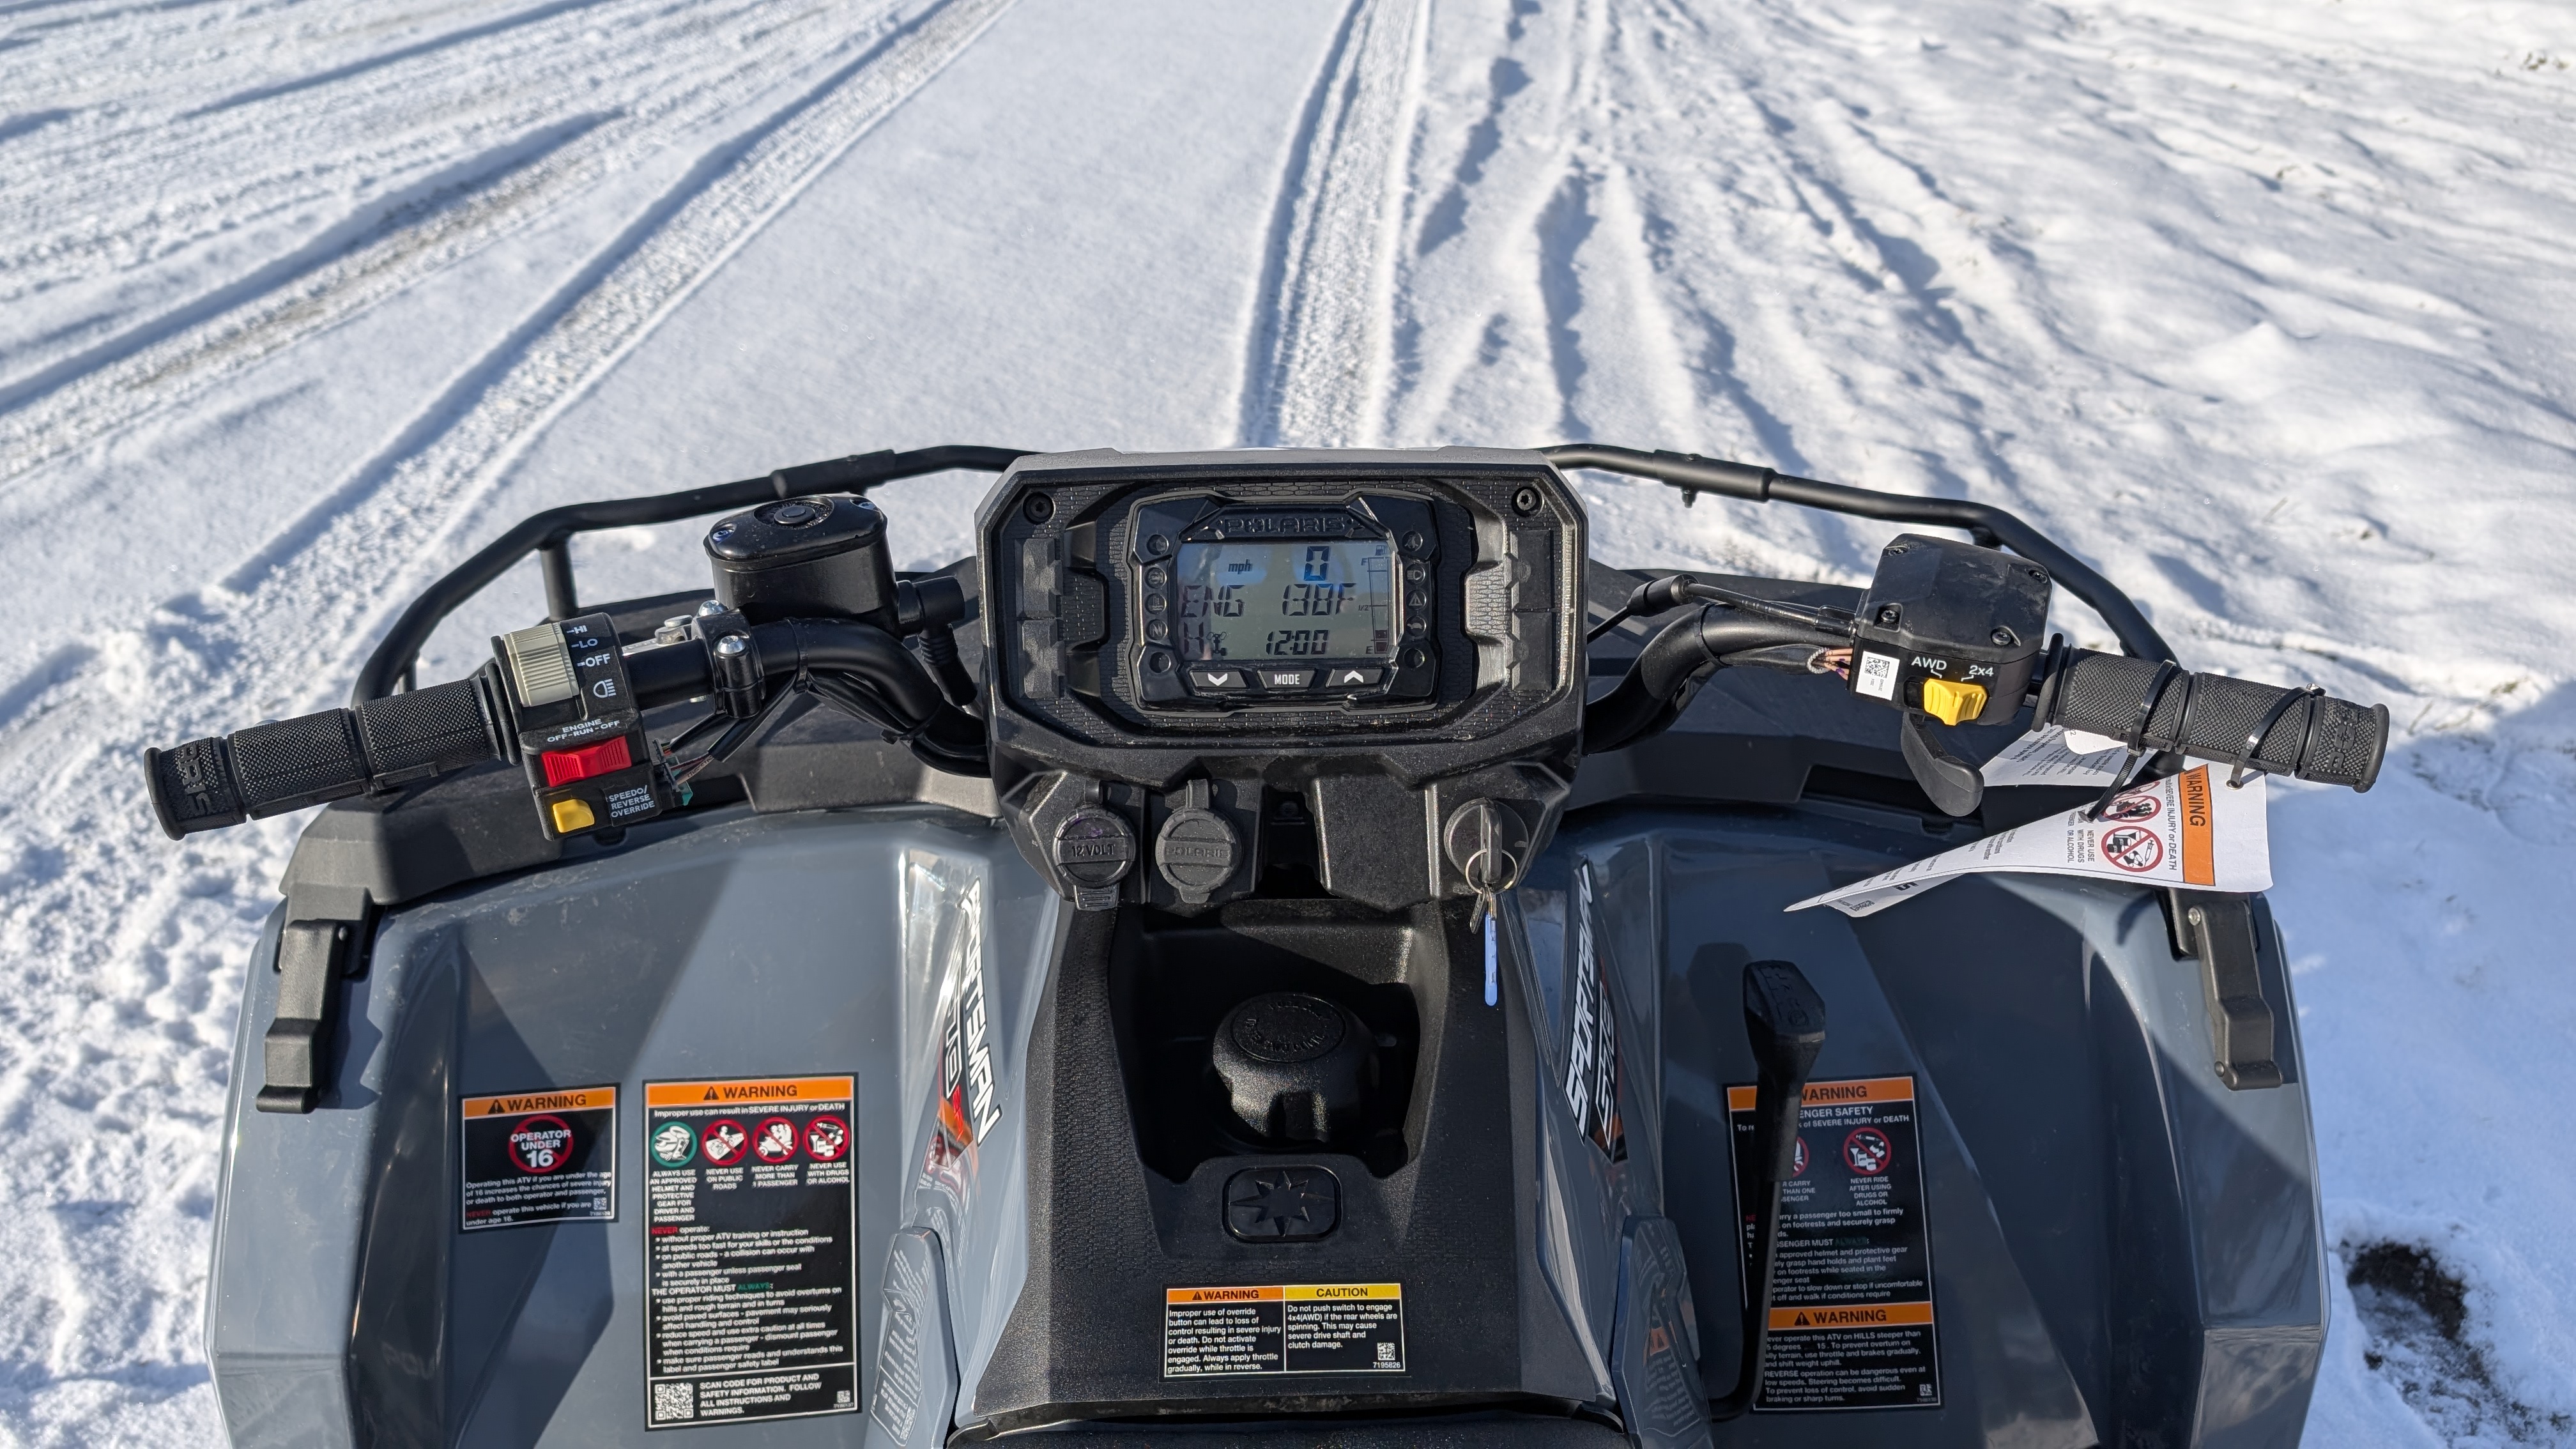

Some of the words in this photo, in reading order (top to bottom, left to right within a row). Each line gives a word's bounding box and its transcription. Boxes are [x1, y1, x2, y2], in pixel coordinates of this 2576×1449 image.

[1224, 517, 1346, 533] POLARIS
[1227, 558, 1253, 574] mph
[1304, 546, 1330, 581] 0
[1181, 585, 1245, 617] ENG
[1183, 622, 1204, 654] H
[1266, 629, 1329, 655] 12:00
[1911, 656, 1947, 670] AWD
[1968, 664, 1994, 677] 2x4
[1274, 673, 1300, 685] MODE
[562, 719, 602, 733] ENGINE
[608, 785, 648, 802] SPEEDO/
[2186, 767, 2206, 827] WARNING
[611, 793, 651, 810] REVERSE
[611, 801, 656, 818] OVERRIDE
[2166, 808, 2177, 833] INJURY
[2087, 830, 2095, 848] NEVER
[2168, 834, 2176, 843] or
[1086, 843, 1116, 857] VOLT
[2077, 841, 2085, 863] DRUGS
[2168, 843, 2177, 871] DEATH
[723, 1084, 797, 1099] WARNING
[507, 1093, 586, 1112] WARNING
[654, 1108, 689, 1118] Improper
[719, 1107, 740, 1115] result
[749, 1105, 779, 1114] SEVERE
[779, 1104, 808, 1112] INJURY
[818, 1102, 845, 1111] DEATH
[1834, 1105, 1874, 1116] SAFETY
[1812, 1118, 1842, 1127] SEVERE
[1843, 1117, 1871, 1125] INJURY
[1883, 1114, 1909, 1123] DEATH
[510, 1128, 571, 1143] OPERATOR
[521, 1138, 560, 1151] UNDER
[526, 1149, 554, 1169] 16
[466, 1179, 500, 1190] Operating
[599, 1170, 611, 1179] age
[669, 1285, 712, 1295] OPERATOR
[713, 1284, 736, 1292] MUST
[1203, 1289, 1259, 1300] WARNING
[1316, 1287, 1368, 1297] CAUTION
[1169, 1309, 1200, 1319] Improper
[1313, 1304, 1330, 1312] push
[1287, 1313, 1322, 1322] 4x4(AWD)
[1812, 1309, 1887, 1324] WARNING
[1195, 1326, 1226, 1336] resulting
[1261, 1324, 1281, 1334] injury
[1287, 1323, 1320, 1331] spinning.
[1168, 1346, 1197, 1354] override
[1312, 1341, 1343, 1349] damage.
[1167, 1355, 1200, 1365] engaged.
[1202, 1354, 1229, 1363] Always
[1230, 1353, 1250, 1363] apply
[1167, 1364, 1202, 1374] gradually,
[699, 1381, 721, 1390] SCAN
[723, 1379, 745, 1388] CODE
[746, 1377, 763, 1386] FOR
[763, 1374, 801, 1384] PRODUCT
[802, 1372, 819, 1381] AND
[700, 1389, 729, 1399] SAFETY
[788, 1381, 822, 1392] FOLLOW
[700, 1399, 714, 1408] ALL
[716, 1395, 772, 1407] INSTRUCTIONS
[773, 1393, 791, 1402] AND
